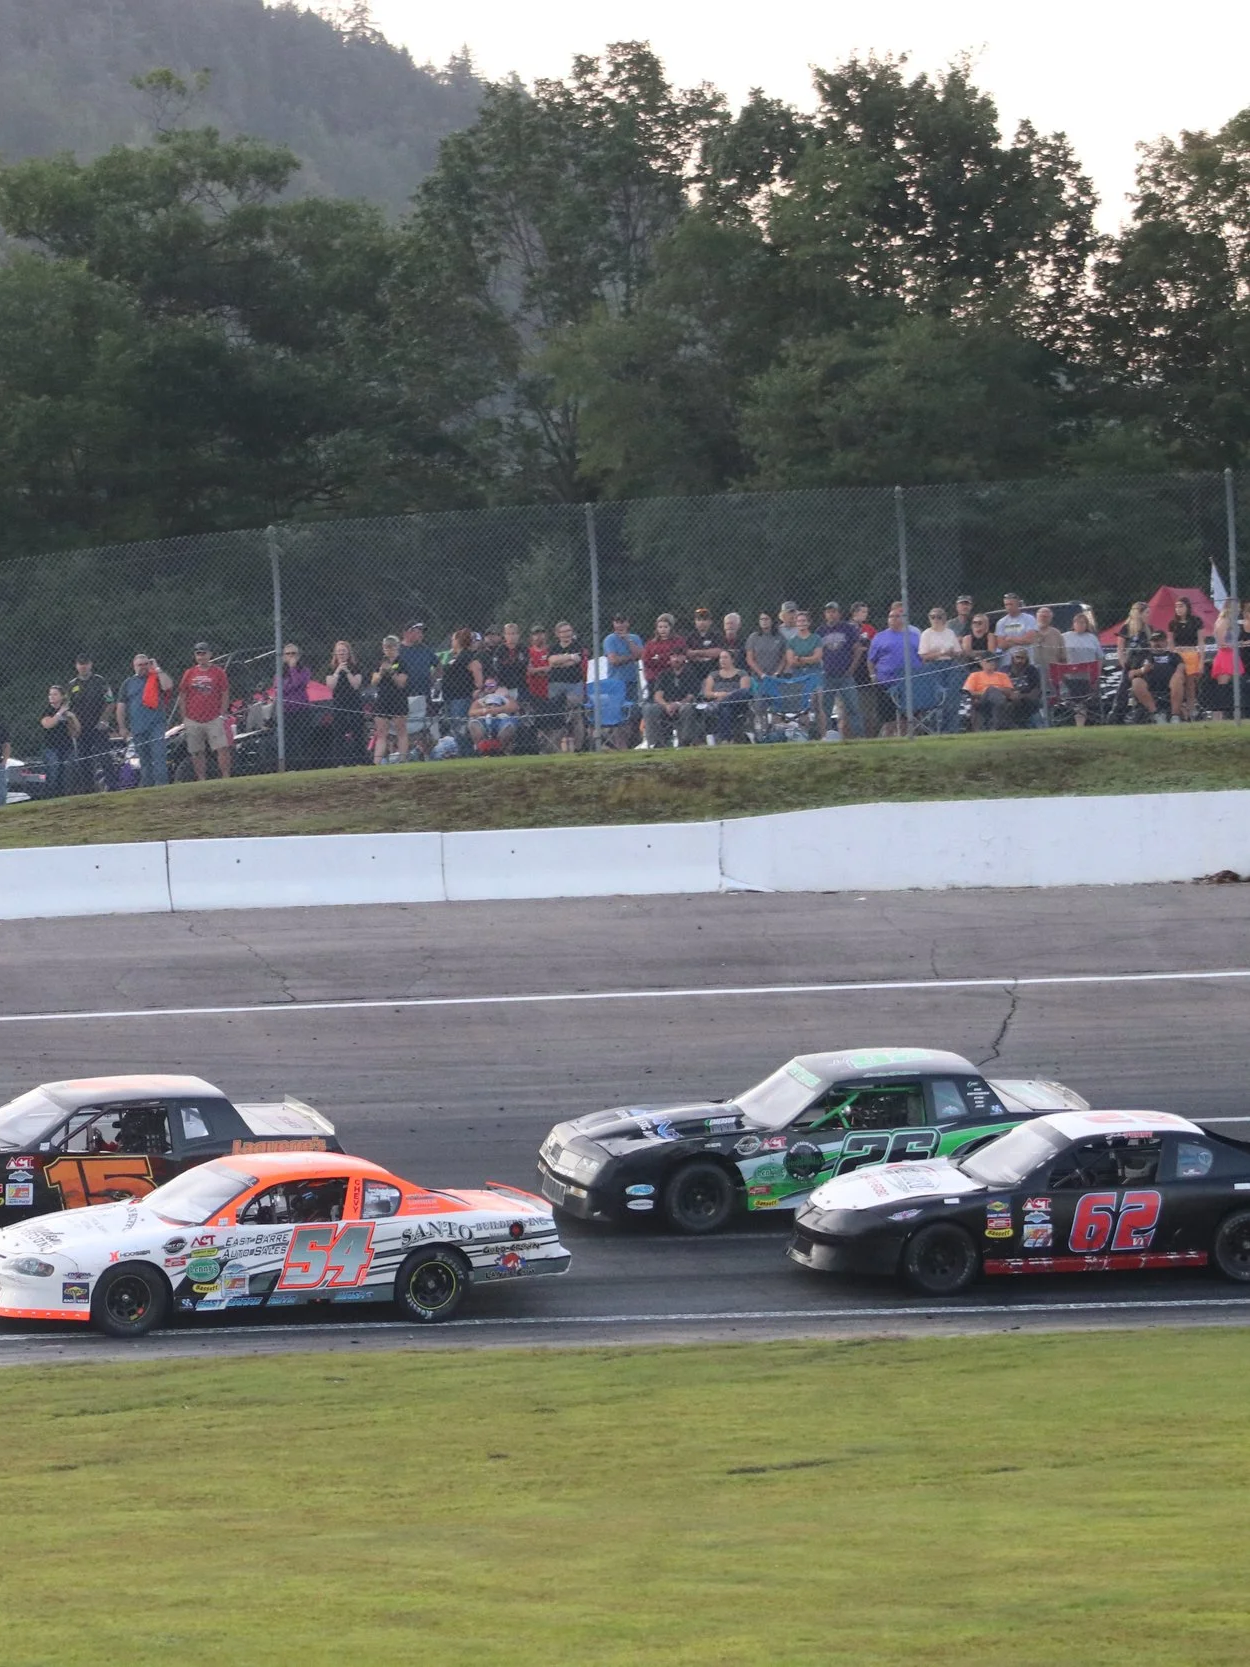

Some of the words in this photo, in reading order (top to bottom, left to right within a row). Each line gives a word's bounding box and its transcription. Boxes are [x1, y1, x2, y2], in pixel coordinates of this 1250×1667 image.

[760, 1136, 787, 1151] ACT
[6, 1156, 35, 1170] ACT
[43, 1155, 157, 1211] 15
[354, 1180, 362, 1214] CHEVY
[1022, 1197, 1052, 1211] ACT
[1068, 1190, 1162, 1252] 62
[191, 1234, 216, 1247] ACT
[255, 1233, 290, 1245] BARRE
[400, 1220, 475, 1249] SANTO
[119, 1249, 151, 1258] HOOSIER
[277, 1222, 376, 1290] 54
[195, 1284, 219, 1292] Bassett
